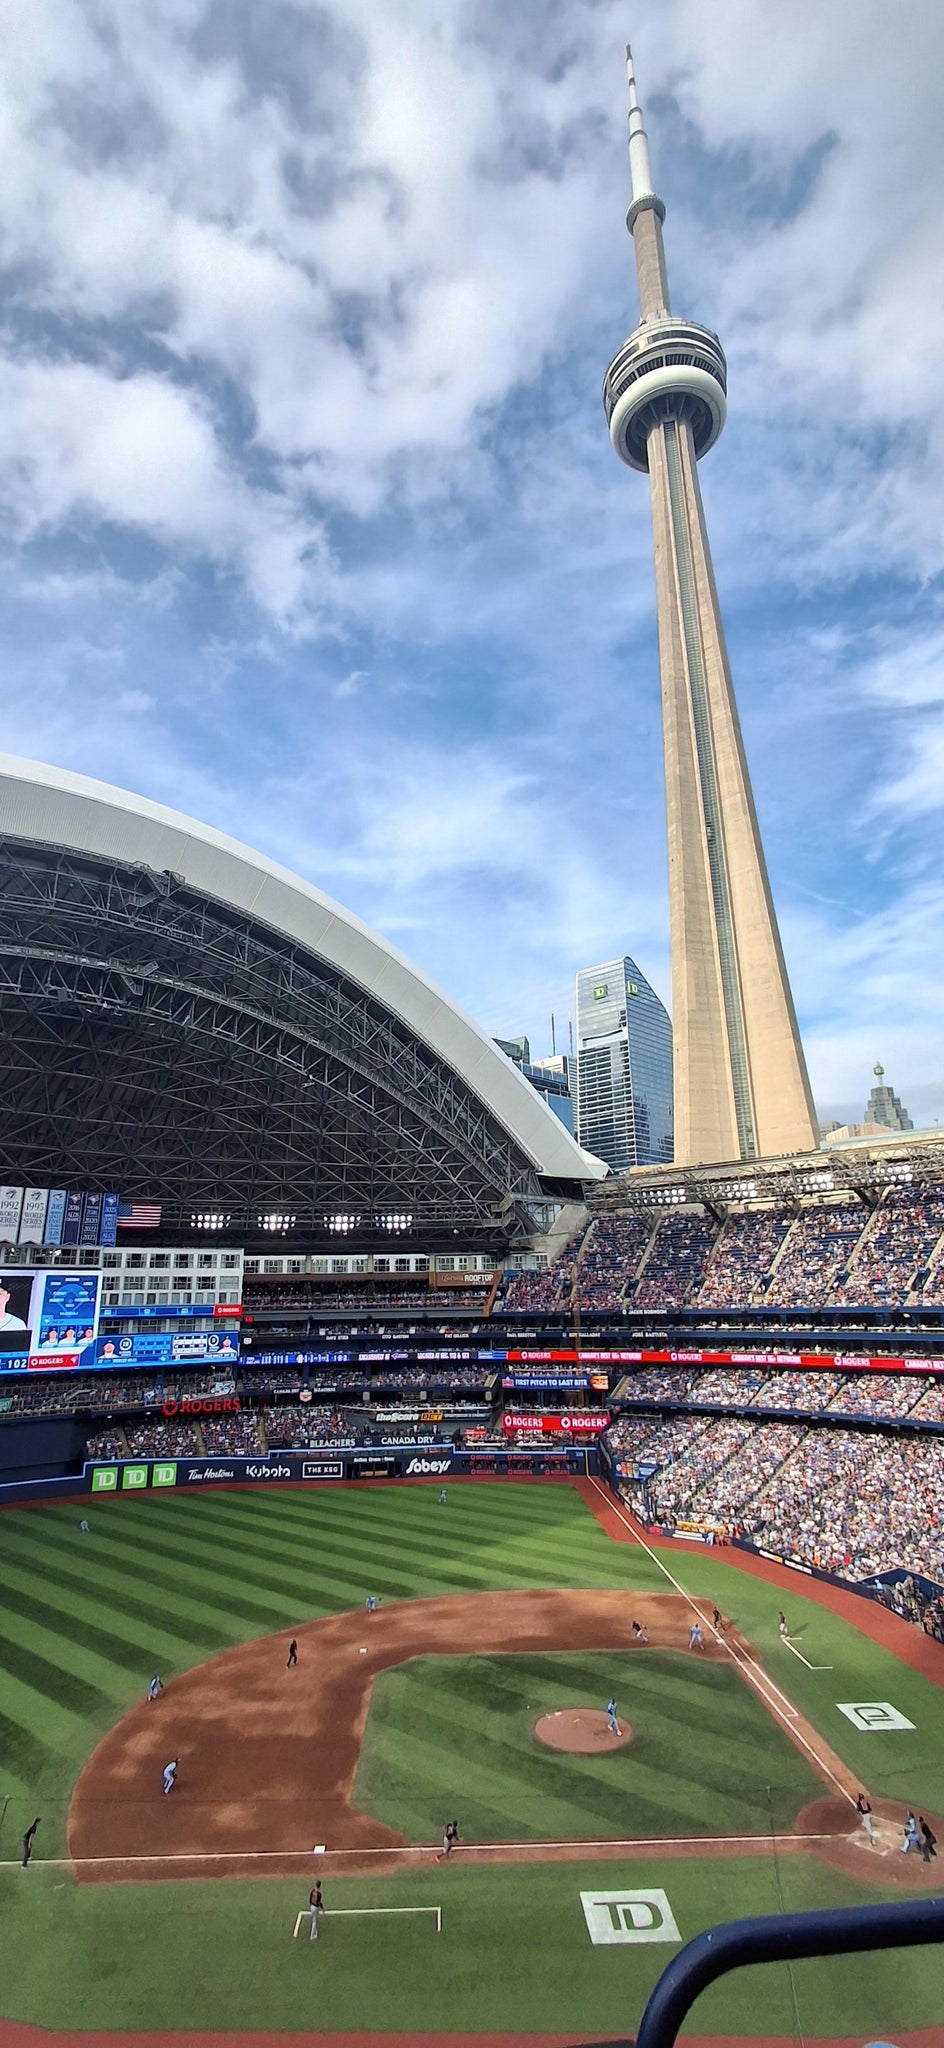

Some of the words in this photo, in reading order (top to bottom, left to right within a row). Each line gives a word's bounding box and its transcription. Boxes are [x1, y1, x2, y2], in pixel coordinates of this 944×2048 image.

[1, 1201, 19, 1210] 1992
[26, 1202, 44, 1211] 1993
[621, 1352, 642, 1360] NETWORK
[678, 1353, 702, 1361] ROGERS
[731, 1354, 754, 1362] CANADA'S
[755, 1354, 766, 1362] BEST
[777, 1355, 801, 1363] NETWORK
[842, 1356, 870, 1366] ROGERS
[8, 1359, 27, 1369] 102
[905, 1359, 932, 1369] CANADA'S
[182, 1397, 240, 1413] ROGERS
[376, 1413, 419, 1421] theScore
[512, 1417, 543, 1427] ROGERS
[572, 1418, 607, 1427] ROGERS
[310, 1438, 356, 1448] BLEACHERS
[381, 1437, 416, 1445] CANADA
[406, 1457, 451, 1474] Sobeys
[156, 1467, 174, 1483] TD
[188, 1469, 203, 1480] Tim
[204, 1467, 234, 1479] Hortons
[246, 1465, 291, 1478] Kubota
[96, 1472, 115, 1487] TD
[126, 1470, 145, 1485] TD
[853, 1706, 895, 1726] TD
[593, 1900, 664, 1931] TD
